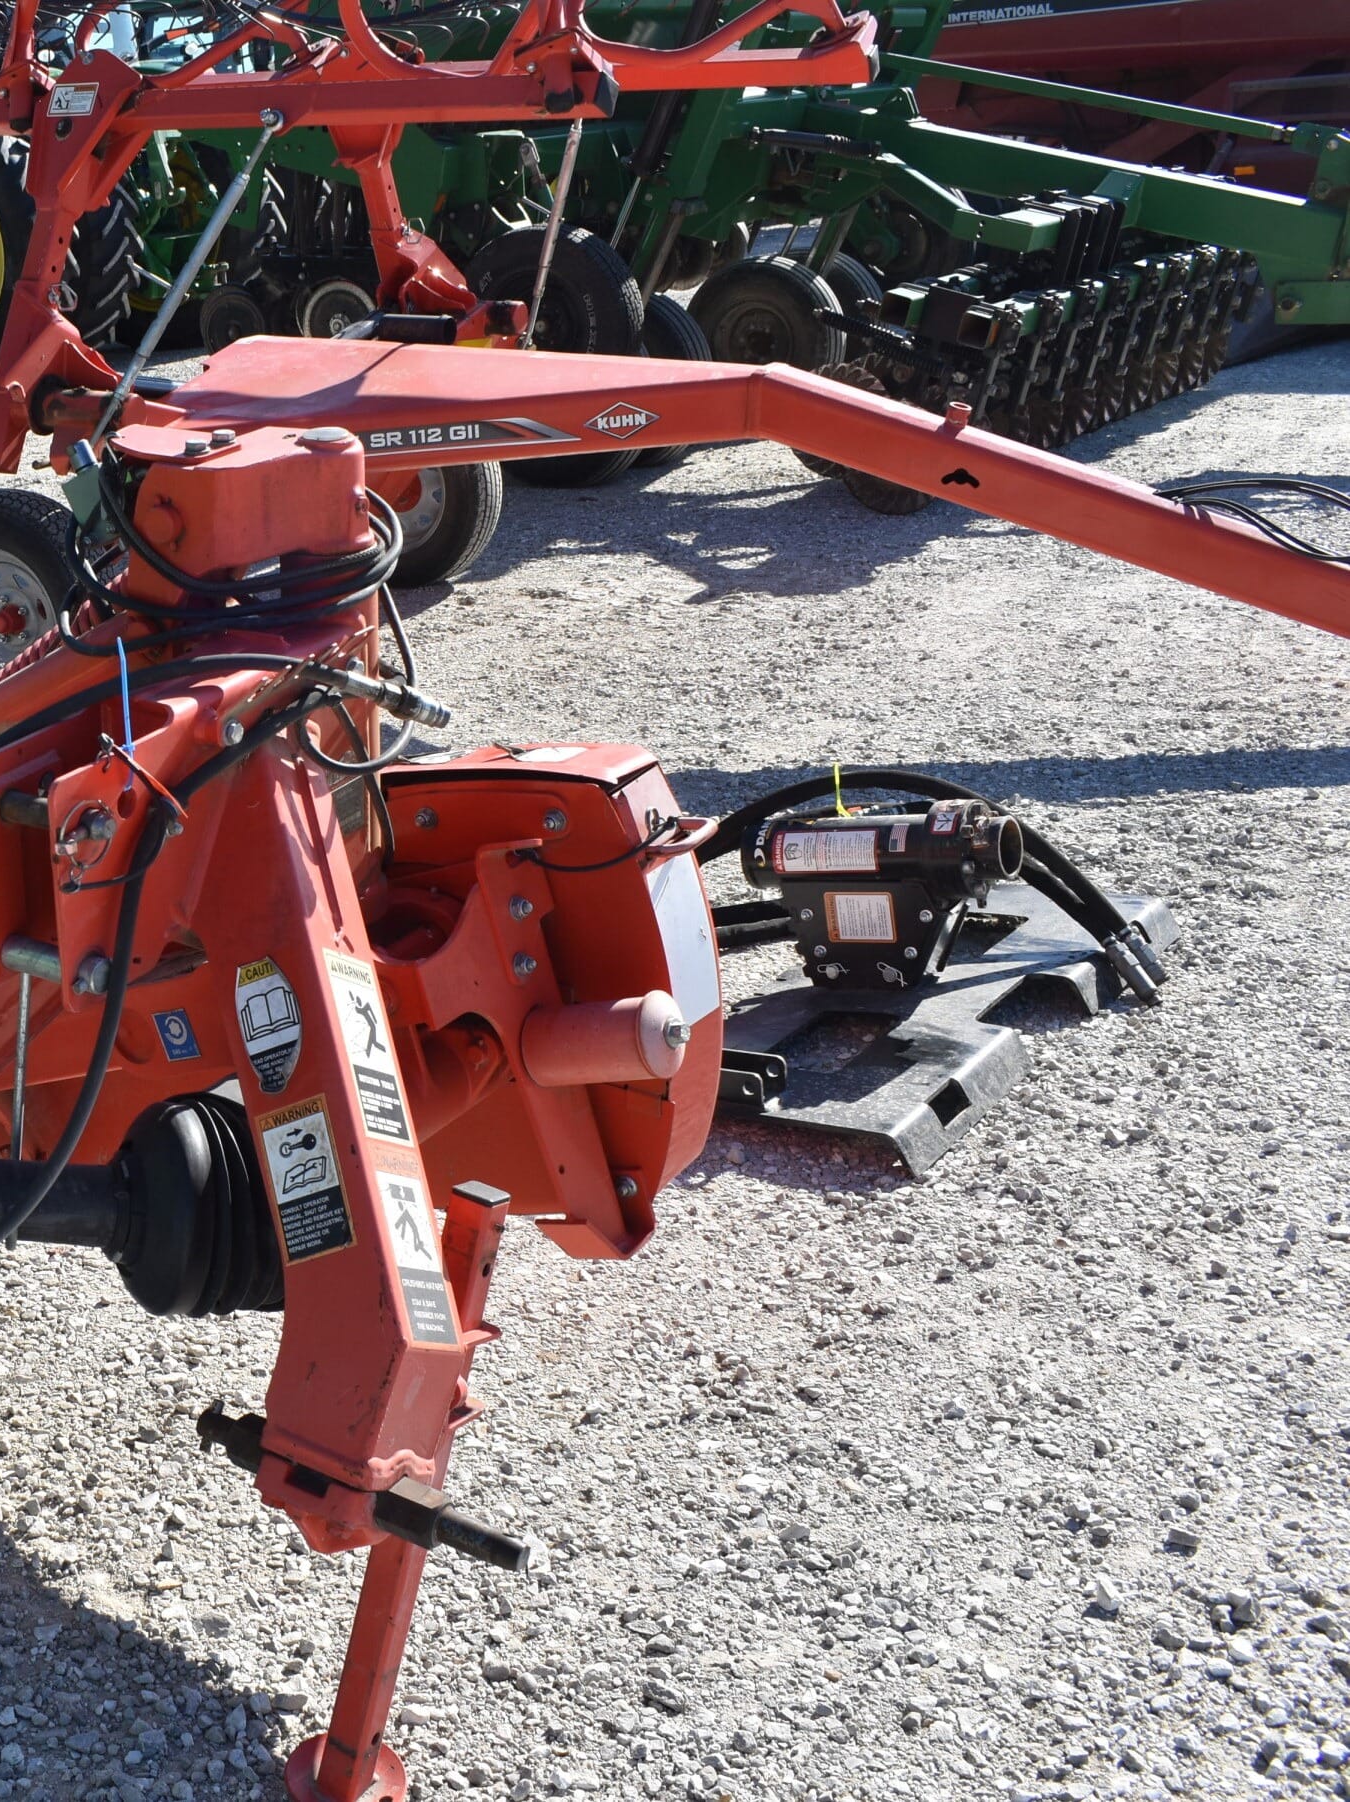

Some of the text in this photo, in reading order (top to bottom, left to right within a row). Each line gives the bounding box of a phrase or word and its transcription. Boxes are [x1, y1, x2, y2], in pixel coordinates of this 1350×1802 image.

[947, 3, 1054, 23] INTERNATIONAL
[597, 412, 647, 431] KUHN
[370, 423, 480, 449] SR 112 GII
[775, 834, 784, 865] DANGER
[335, 961, 372, 985] WARNING
[272, 1102, 320, 1127] WARNING
[281, 1195, 329, 1216] CONSULT OPERATOR
[302, 1217, 313, 1225] AND
[313, 1211, 333, 1222] REMOVE
[285, 1229, 305, 1239] BEFORE
[287, 1231, 321, 1246] MAINTENANCE
